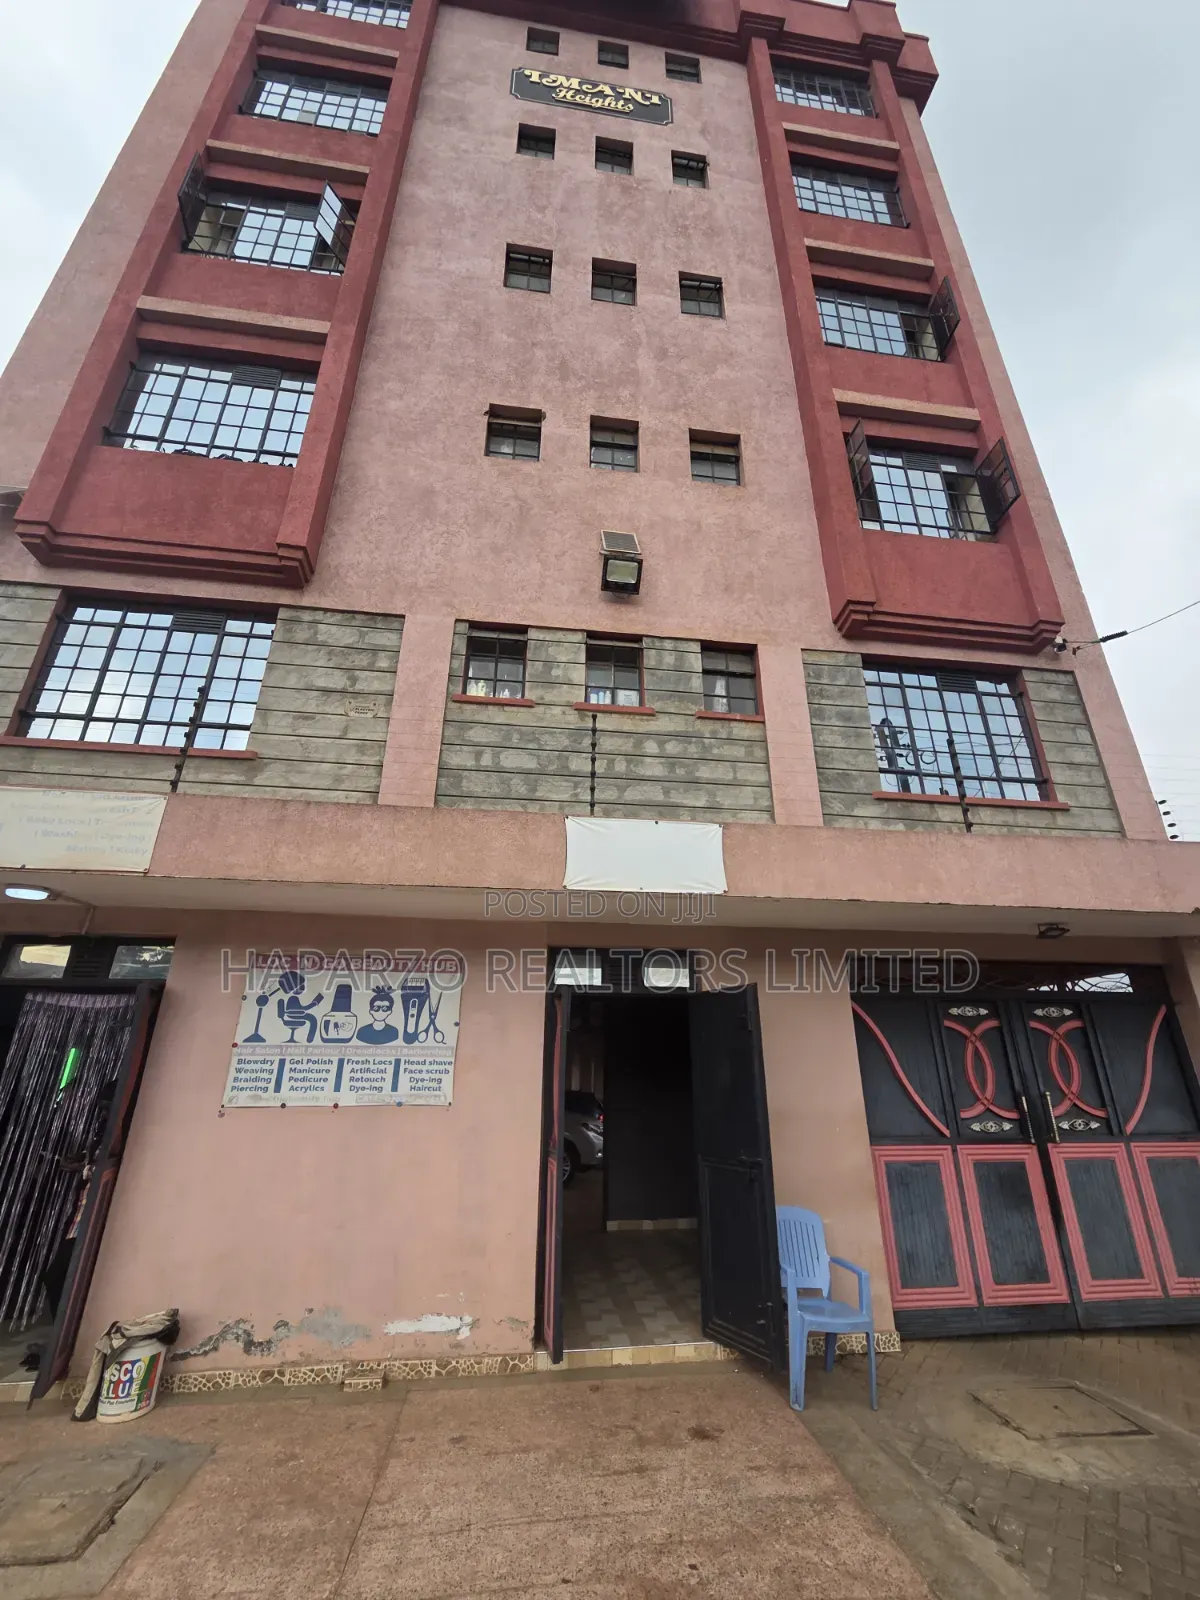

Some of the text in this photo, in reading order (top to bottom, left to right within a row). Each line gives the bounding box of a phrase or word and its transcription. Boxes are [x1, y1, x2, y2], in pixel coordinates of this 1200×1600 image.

[523, 69, 662, 105] IMANI
[552, 87, 634, 113] Heights
[421, 960, 457, 972] HUB
[236, 1058, 275, 1067] Blowdry
[289, 1058, 334, 1066] Gel Polish
[346, 1058, 393, 1066] Fresh Locs
[403, 1059, 454, 1067] Head shave
[235, 1067, 274, 1076] Weaving
[288, 1067, 331, 1075] Manicure
[349, 1067, 388, 1075] Artificial
[425, 1068, 450, 1076] scrub
[232, 1076, 272, 1086] Braiding
[288, 1076, 329, 1084] Pedicure
[349, 1076, 386, 1084] Retouch
[409, 1077, 443, 1086] Dye-ing
[230, 1085, 269, 1094] Piercing
[288, 1085, 325, 1095] Acrylics
[349, 1085, 384, 1094] Dye-ing
[409, 1085, 443, 1093] Haircut
[101, 1383, 141, 1398] ALUE
